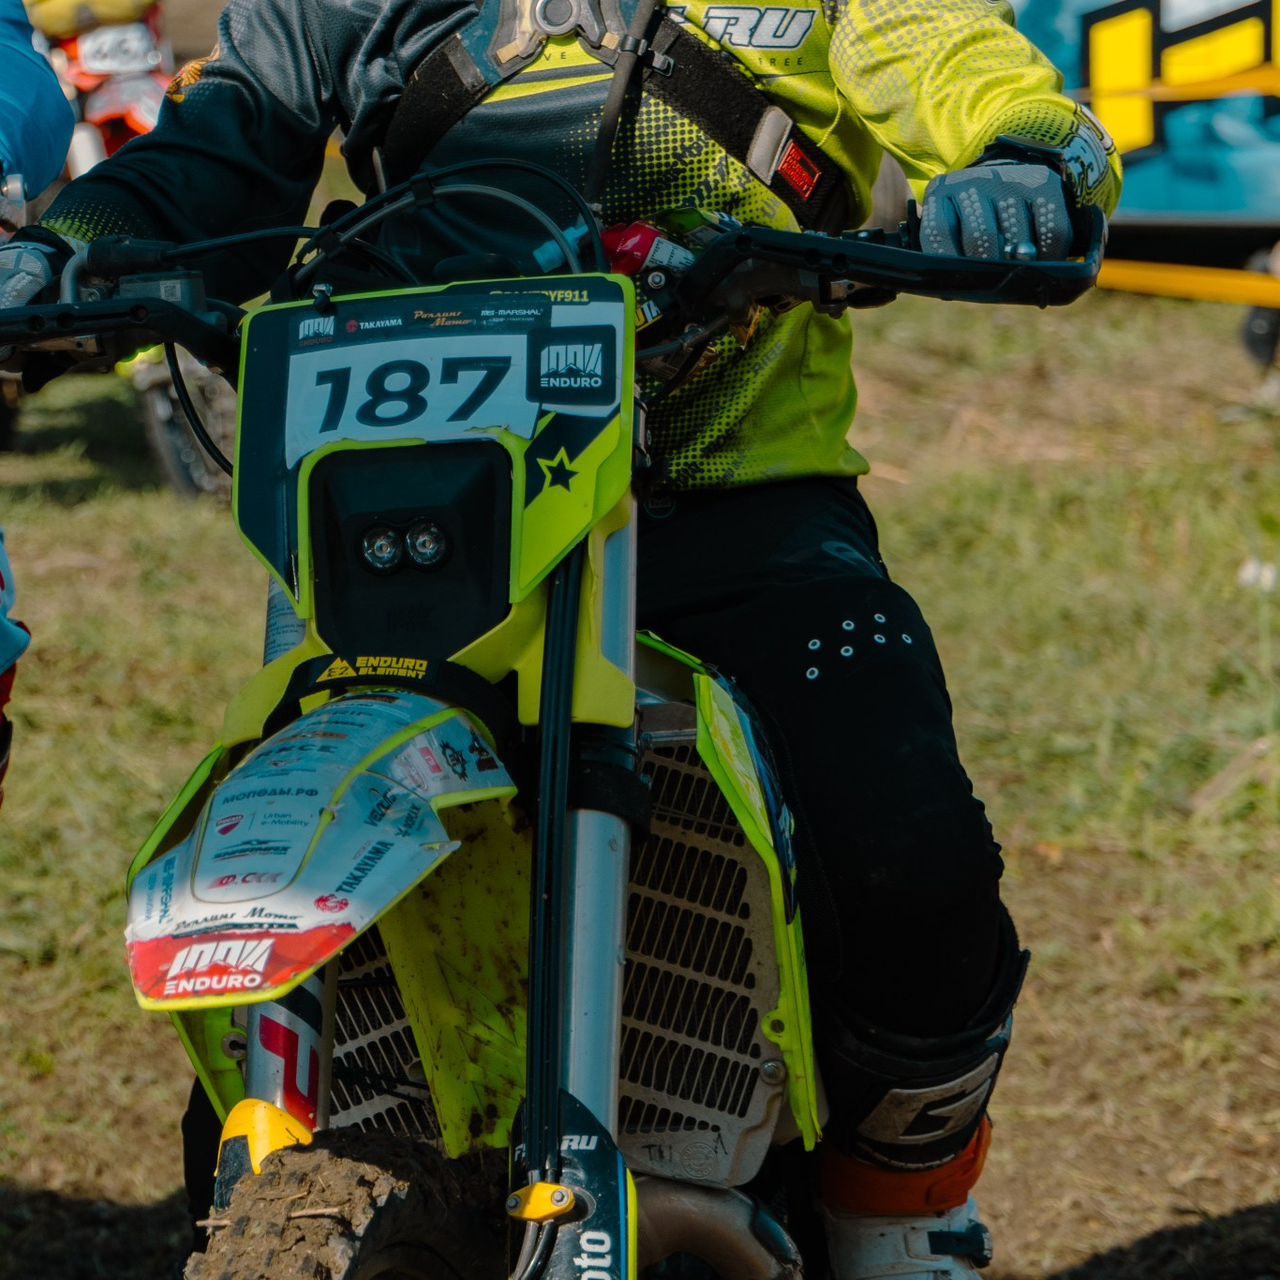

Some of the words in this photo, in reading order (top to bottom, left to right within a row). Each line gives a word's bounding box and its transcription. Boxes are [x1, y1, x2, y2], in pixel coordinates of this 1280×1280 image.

[758, 57, 804, 66] FREE
[359, 318, 402, 330] TAKAYAMA
[540, 377, 602, 388] ENDURO
[314, 355, 513, 433] 187
[356, 656, 428, 671] ENDURO
[358, 667, 426, 679] ELEMENT
[260, 819, 310, 827] e-Mobility
[335, 840, 394, 894] TAKAYAMA
[242, 906, 303, 920] Мото
[164, 974, 262, 996] ENDURO
[560, 1134, 598, 1151] RU
